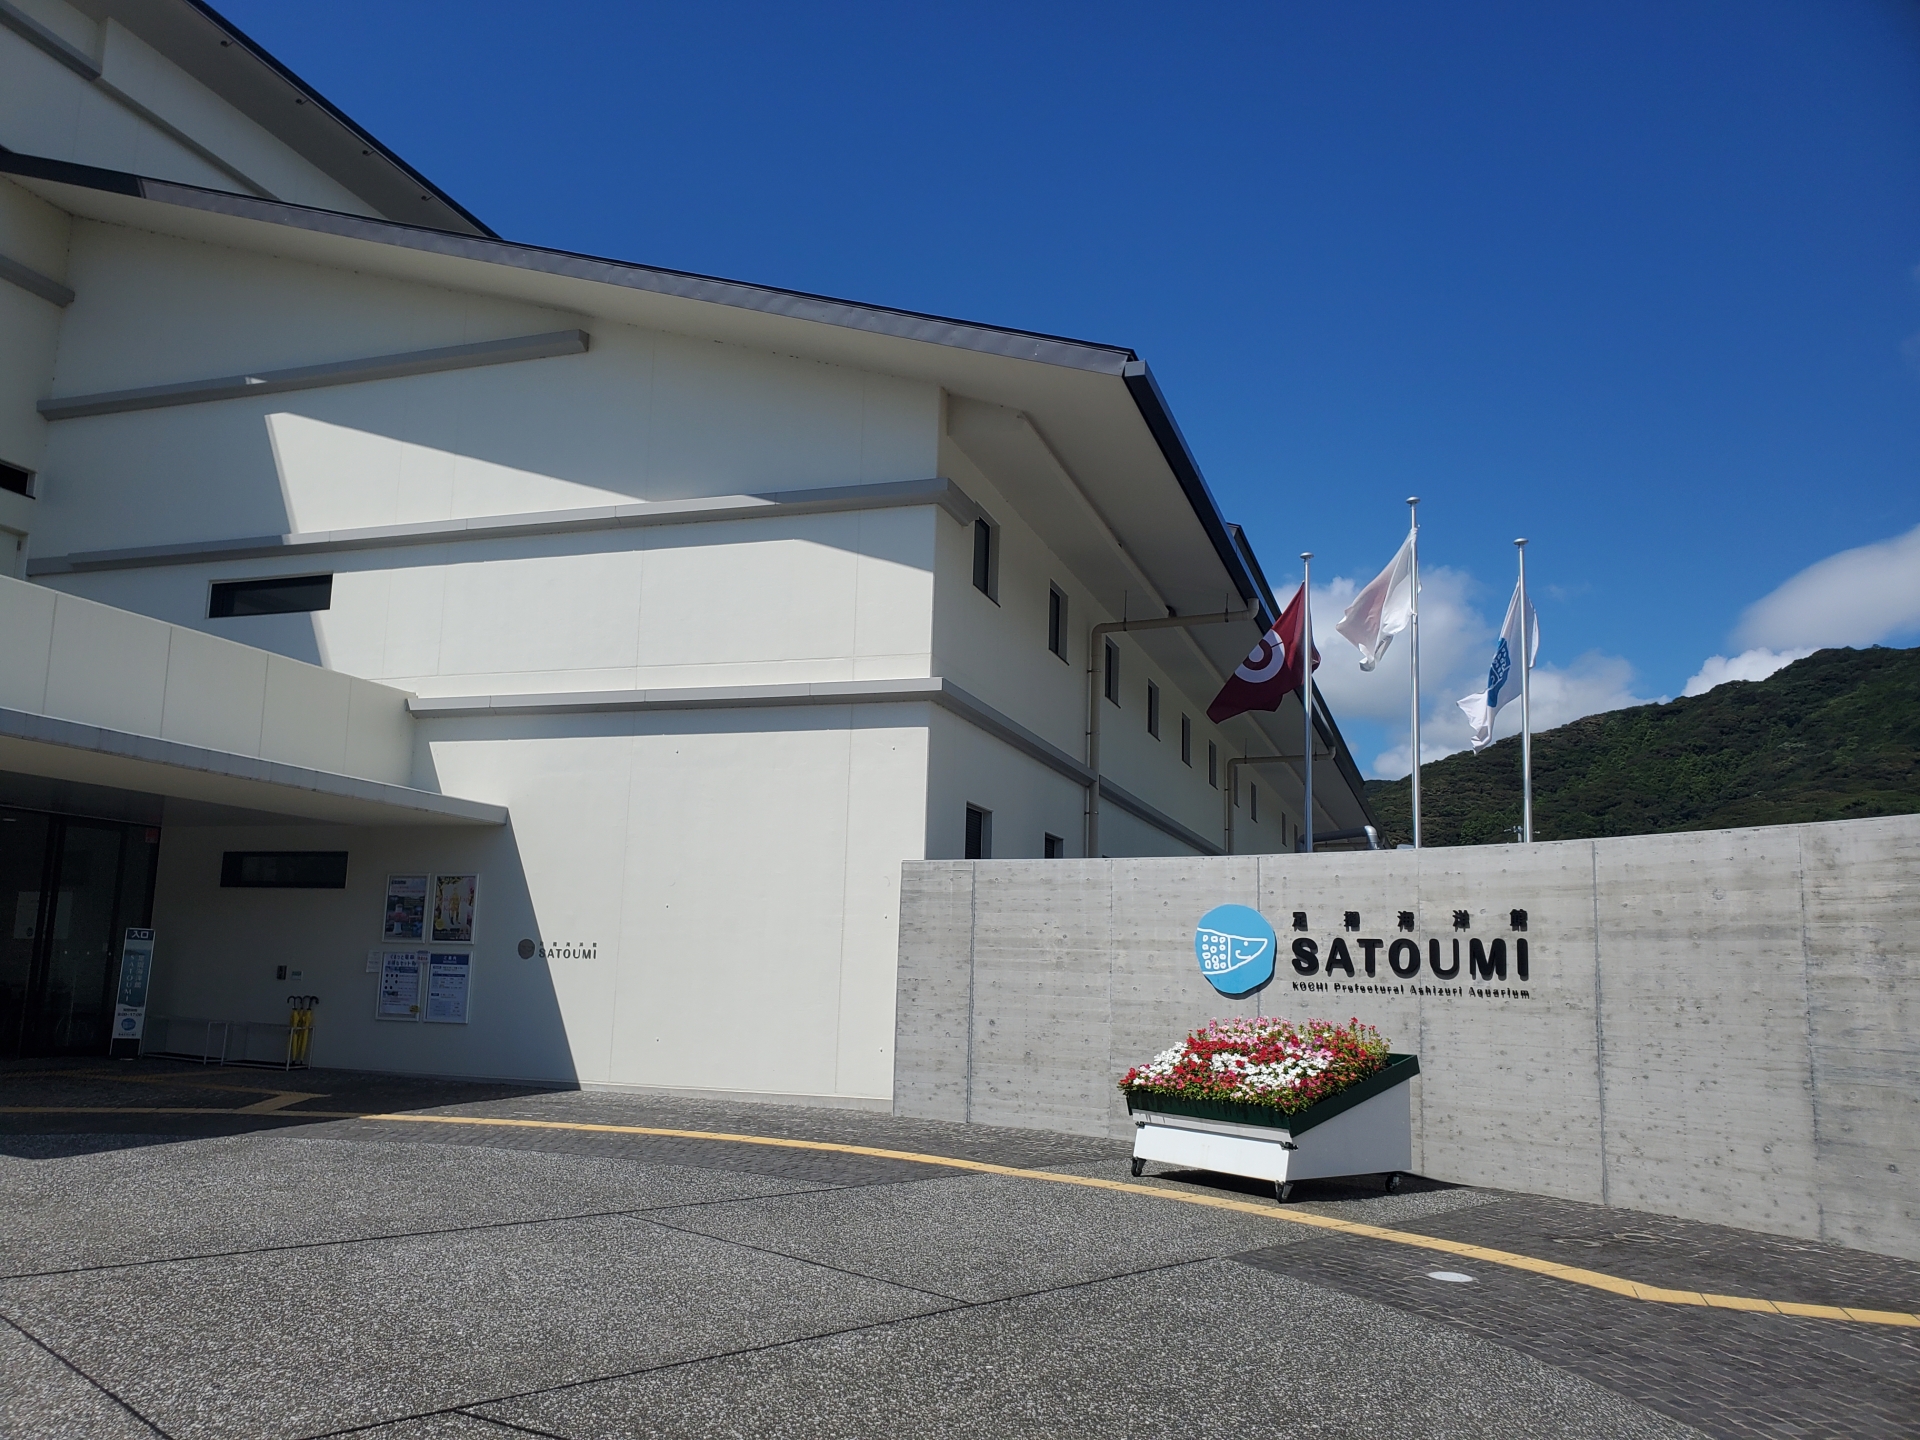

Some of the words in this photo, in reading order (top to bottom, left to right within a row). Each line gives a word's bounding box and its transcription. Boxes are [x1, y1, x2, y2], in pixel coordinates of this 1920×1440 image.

[1291, 908, 1529, 932] 足摺海洋館
[131, 930, 150, 939] 入口
[538, 948, 597, 960] SATOUMI
[1291, 937, 1530, 981] SATOUMI
[1292, 981, 1329, 992] KOCHI
[1333, 982, 1405, 995] Prefectural
[1409, 984, 1463, 997] Ashizuri
[1468, 986, 1530, 999] Aquarium
